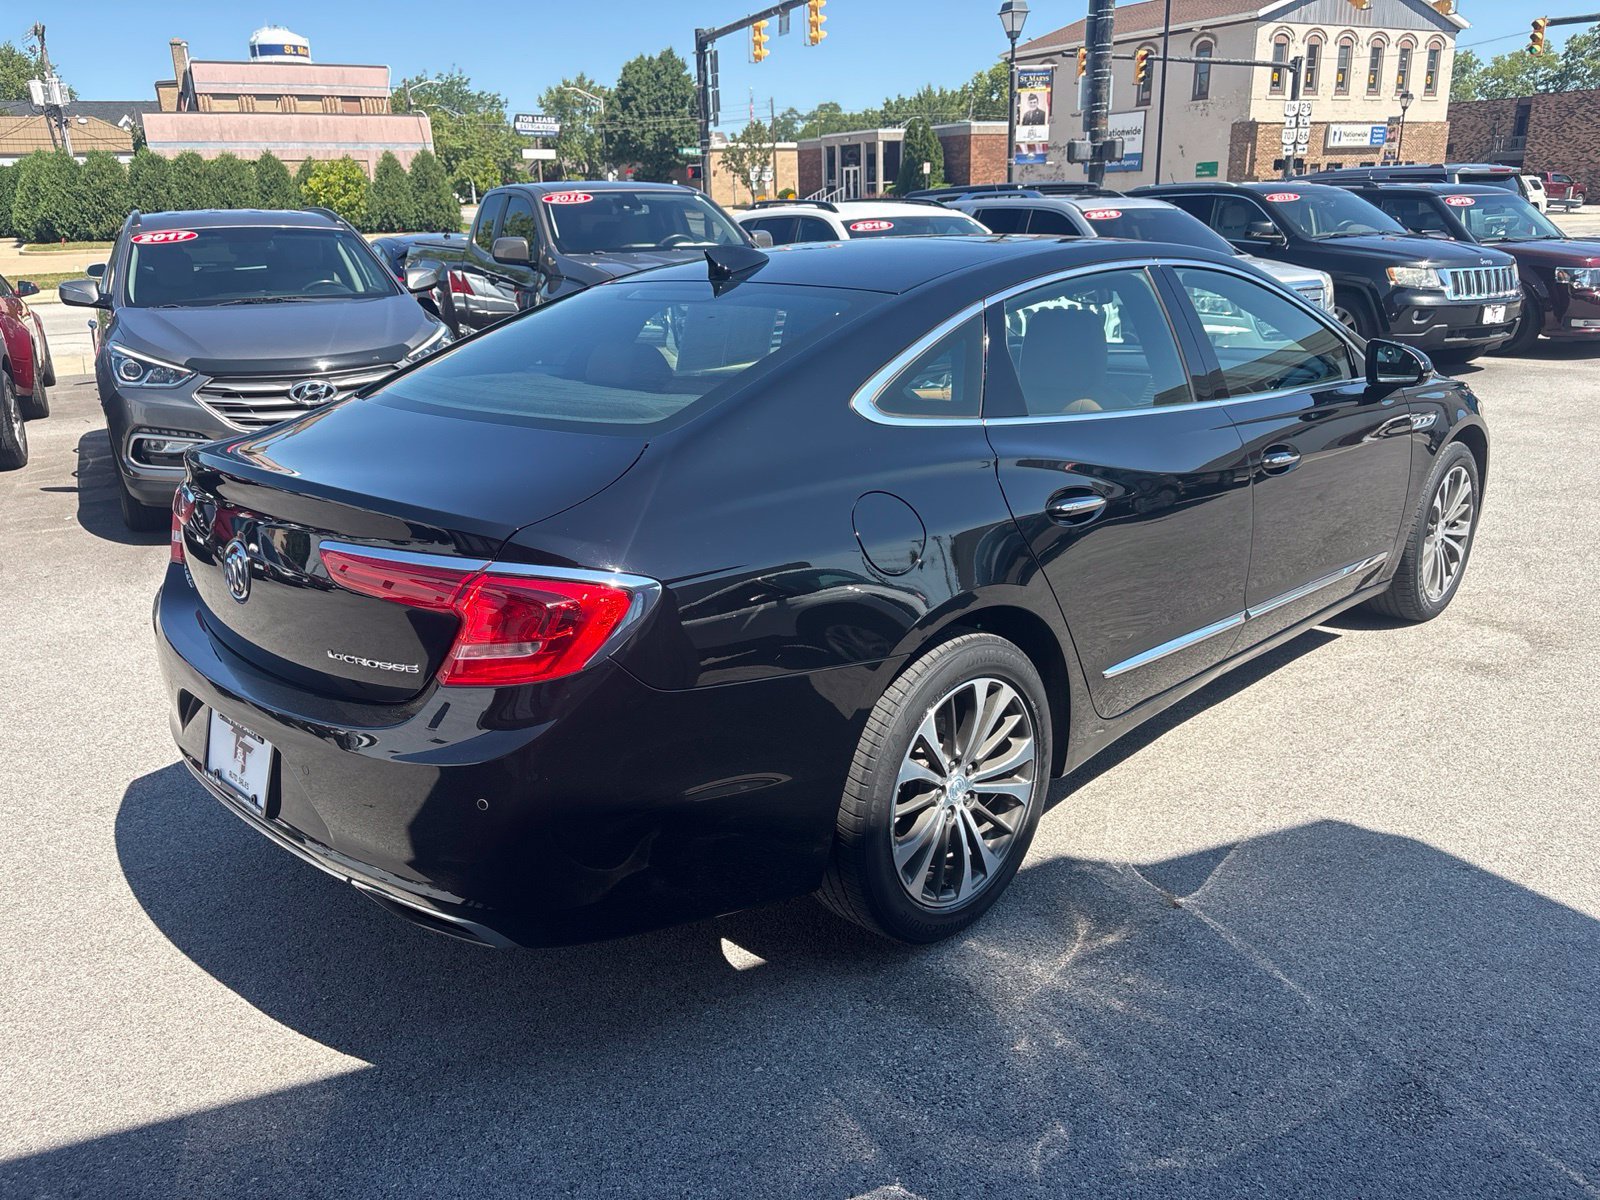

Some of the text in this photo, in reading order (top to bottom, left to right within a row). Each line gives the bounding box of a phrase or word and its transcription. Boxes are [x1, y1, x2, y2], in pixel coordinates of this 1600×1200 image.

[1287, 104, 1296, 112] 116
[1301, 103, 1311, 112] 29
[1299, 131, 1308, 140] 66
[139, 231, 192, 242] 2017
